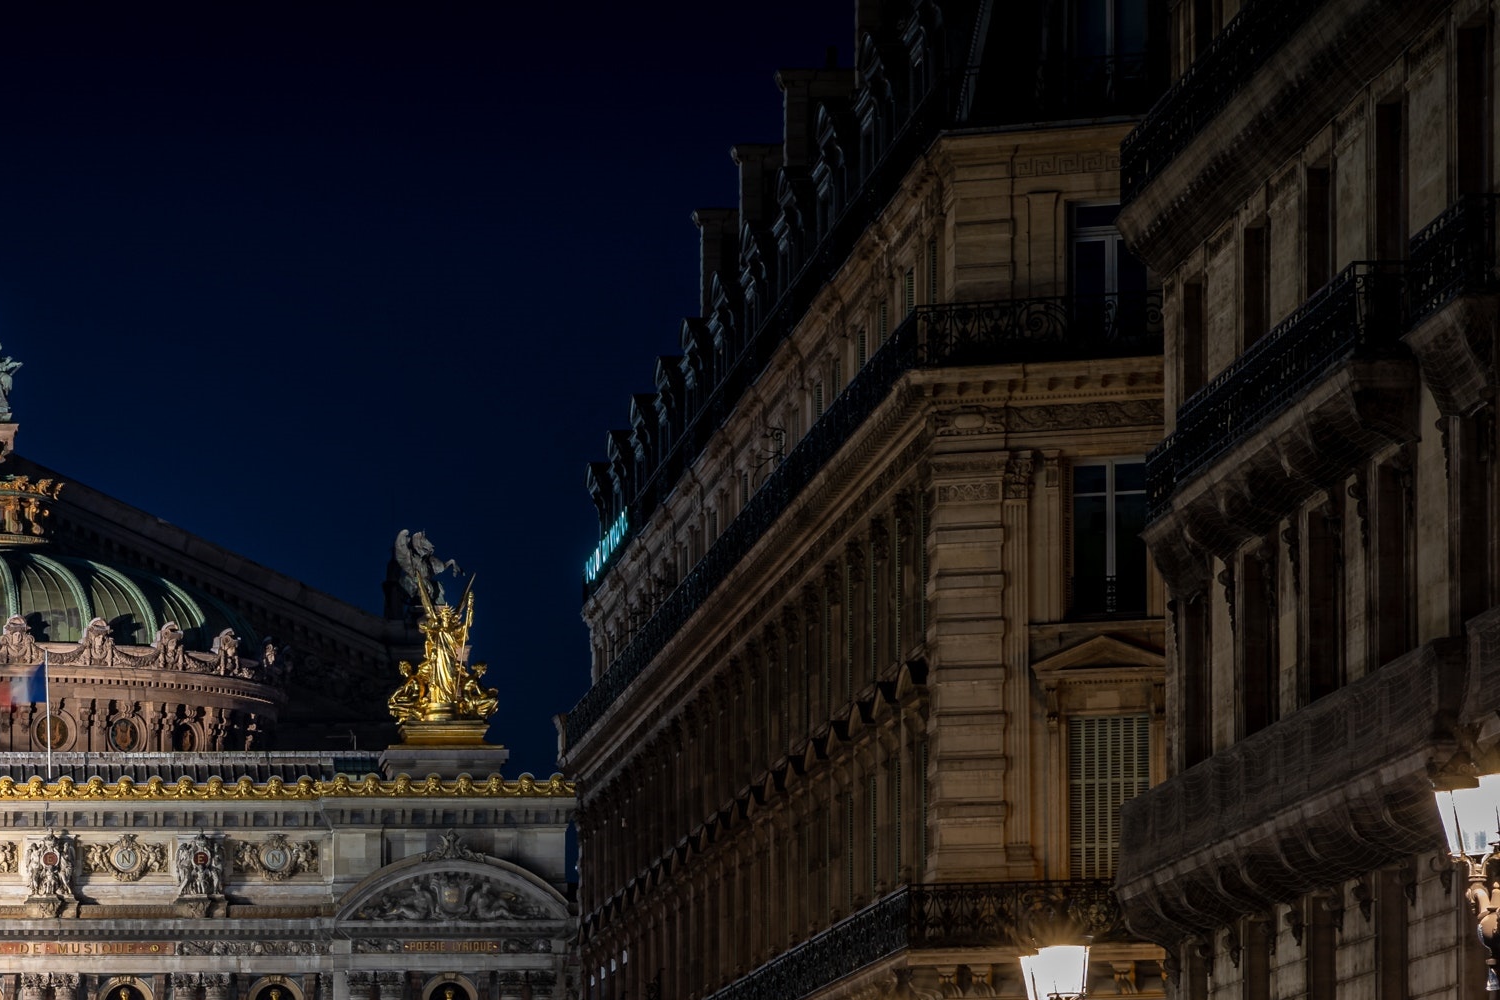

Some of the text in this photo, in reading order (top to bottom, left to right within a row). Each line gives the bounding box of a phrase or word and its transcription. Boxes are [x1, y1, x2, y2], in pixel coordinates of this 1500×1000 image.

[19, 944, 42, 954] DE
[56, 943, 135, 955] MUSIQUE
[410, 941, 446, 951] POESIE
